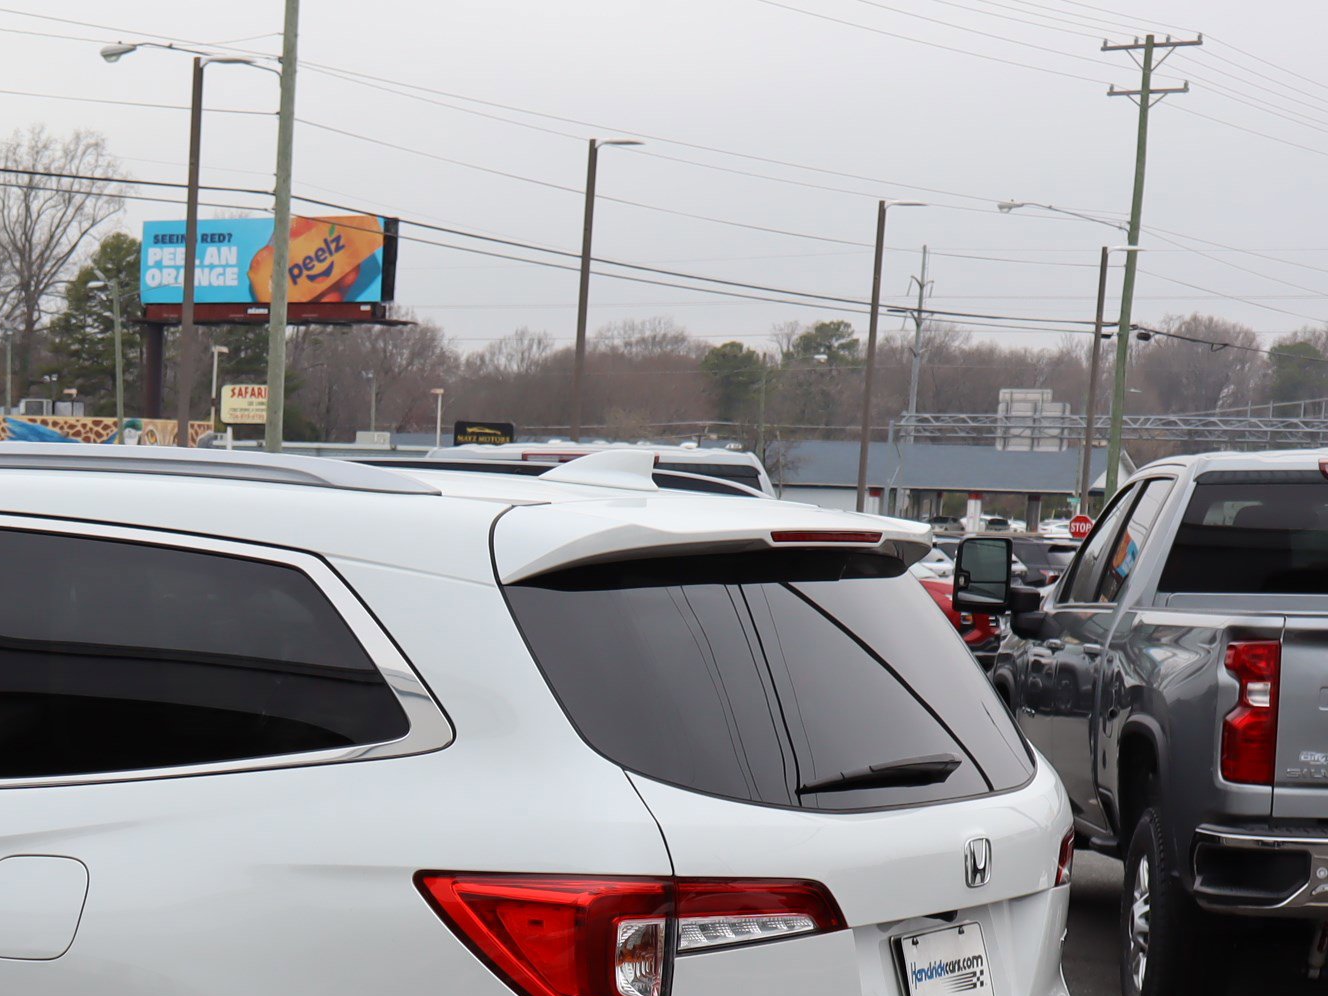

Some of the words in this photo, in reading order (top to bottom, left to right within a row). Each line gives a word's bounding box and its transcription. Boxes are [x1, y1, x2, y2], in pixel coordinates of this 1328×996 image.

[153, 233, 198, 244] SEEIN
[201, 233, 233, 243] RED?
[147, 247, 200, 266] PEE
[204, 246, 238, 265] AN
[288, 234, 346, 286] peelz
[230, 386, 268, 398] SAFARI
[1070, 523, 1092, 533] STOP
[910, 955, 984, 990] Hendrickcars.com
